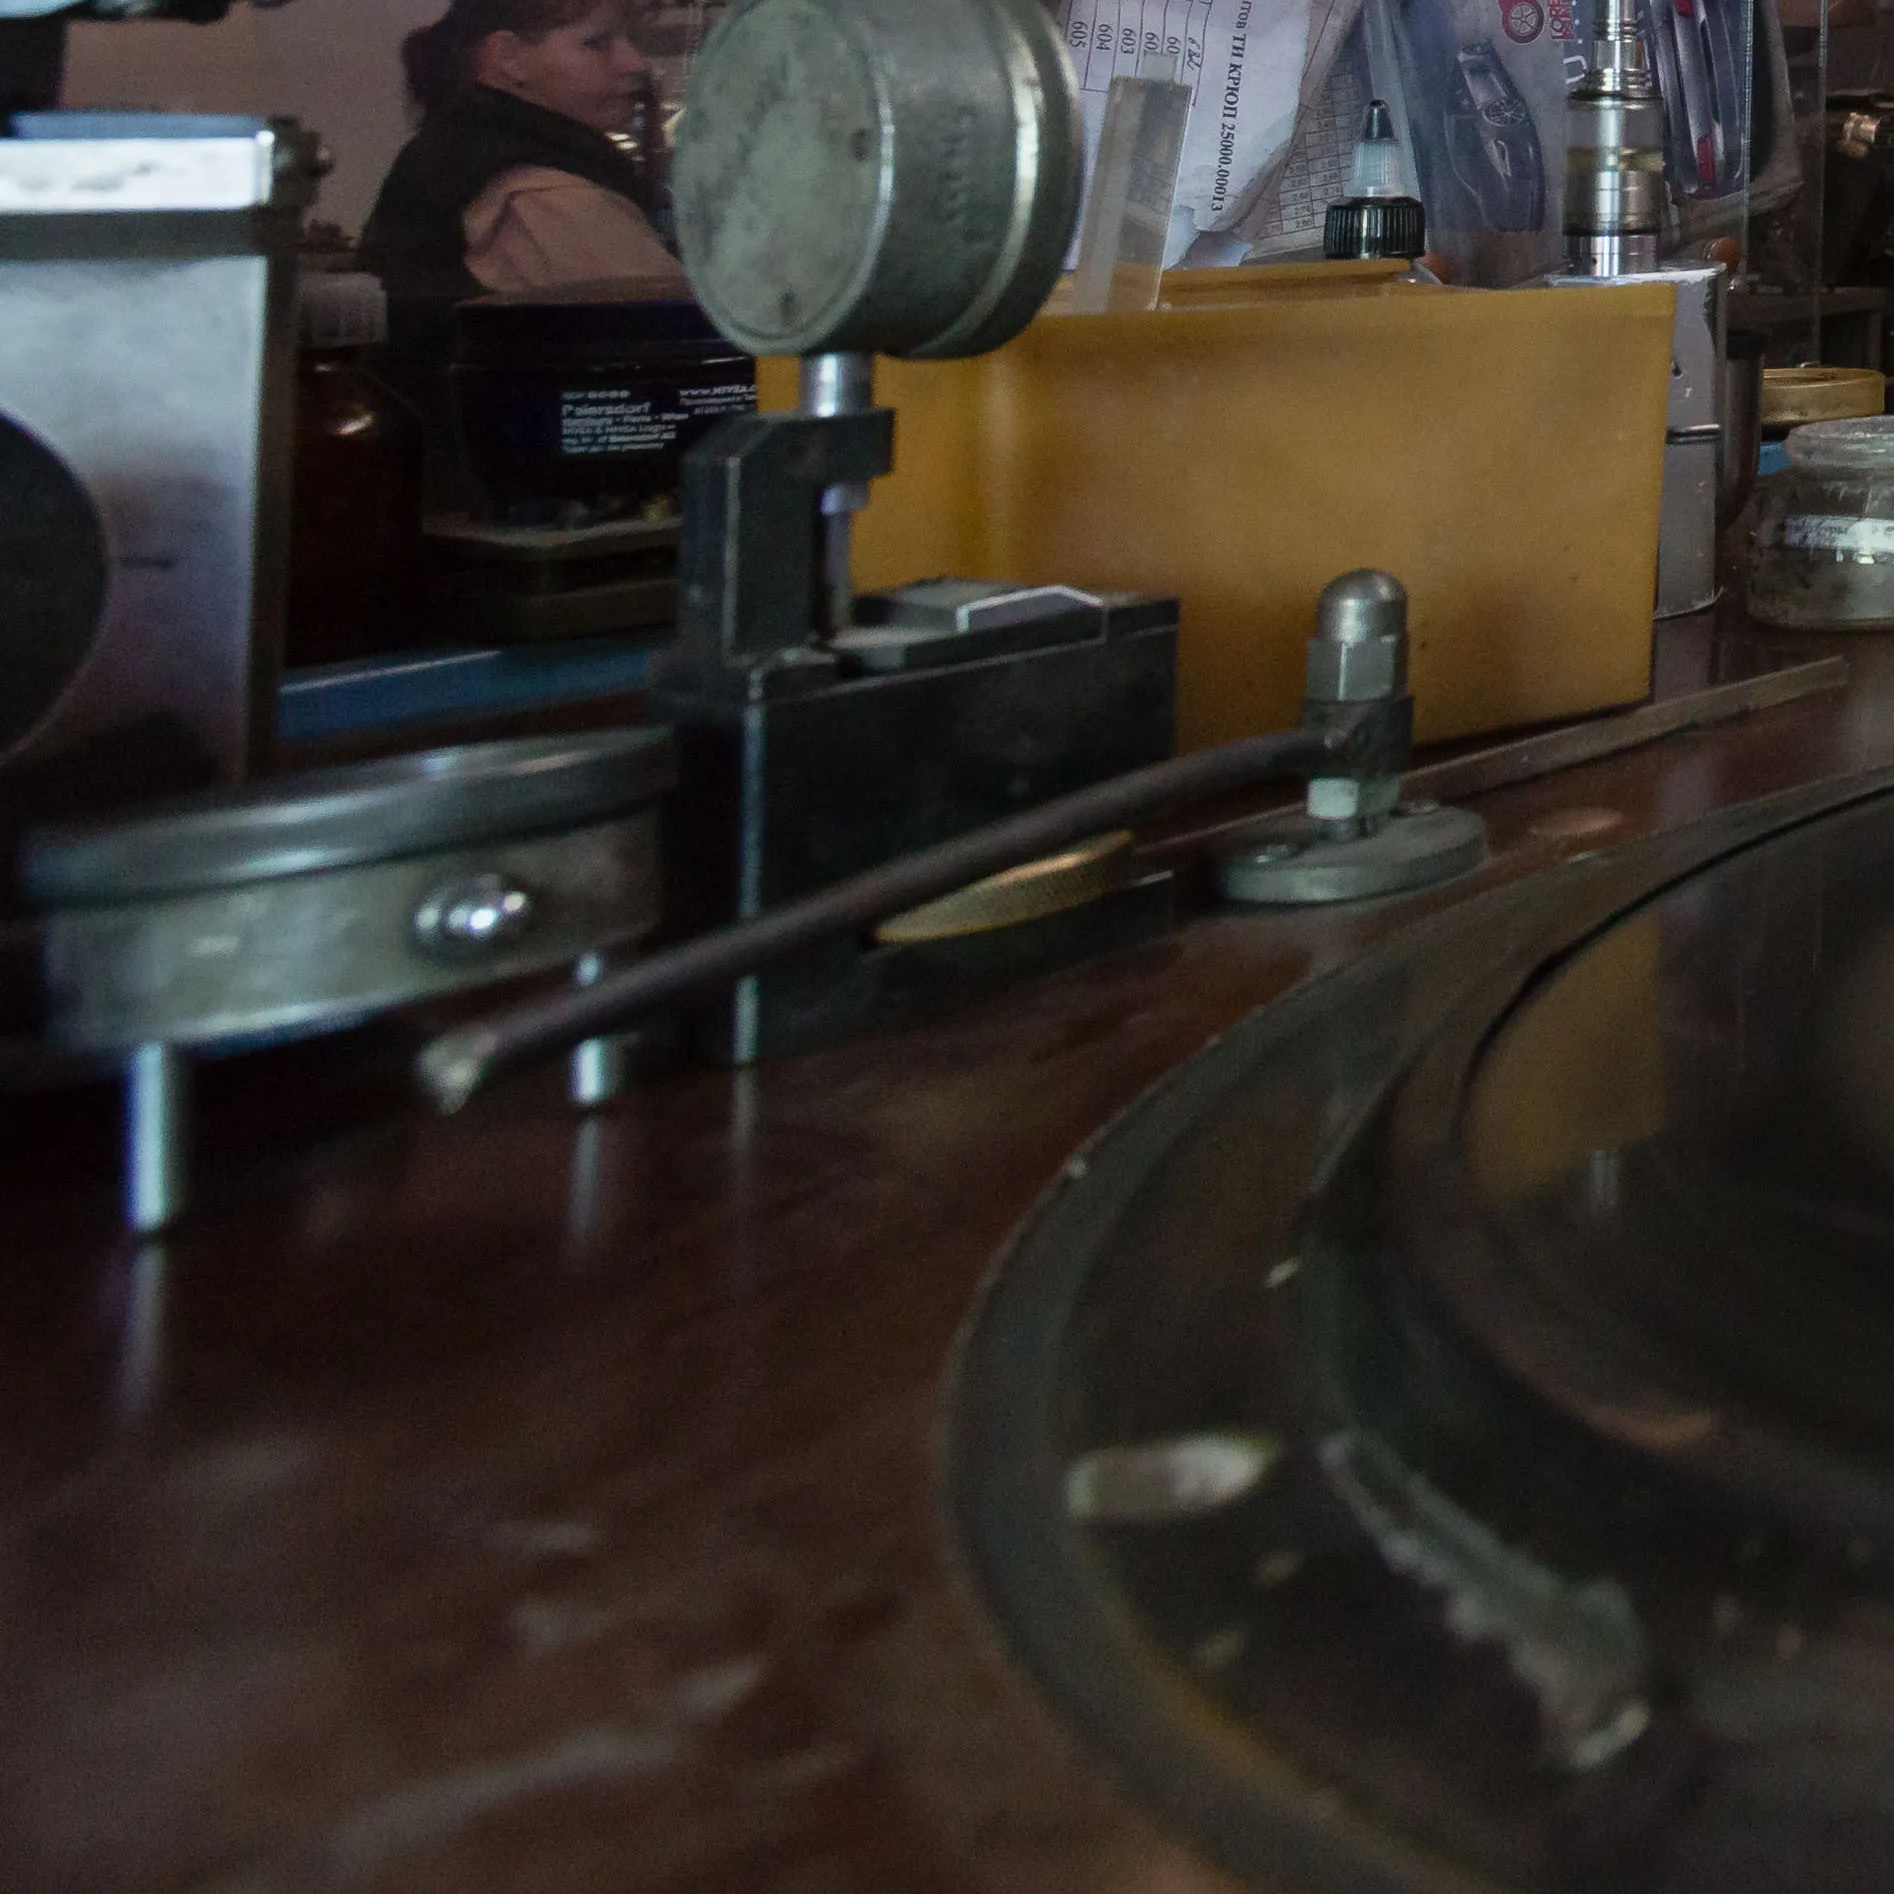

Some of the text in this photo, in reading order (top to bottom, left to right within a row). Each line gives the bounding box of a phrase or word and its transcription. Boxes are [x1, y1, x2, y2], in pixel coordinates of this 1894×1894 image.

[1069, 21, 1089, 48] 605
[1095, 23, 1113, 51] 604
[1120, 28, 1137, 55] 603
[1166, 36, 1181, 55] 60
[1231, 34, 1247, 54] ТИ
[1222, 63, 1243, 120] КРЮП
[1211, 122, 1236, 212] 25000.00013
